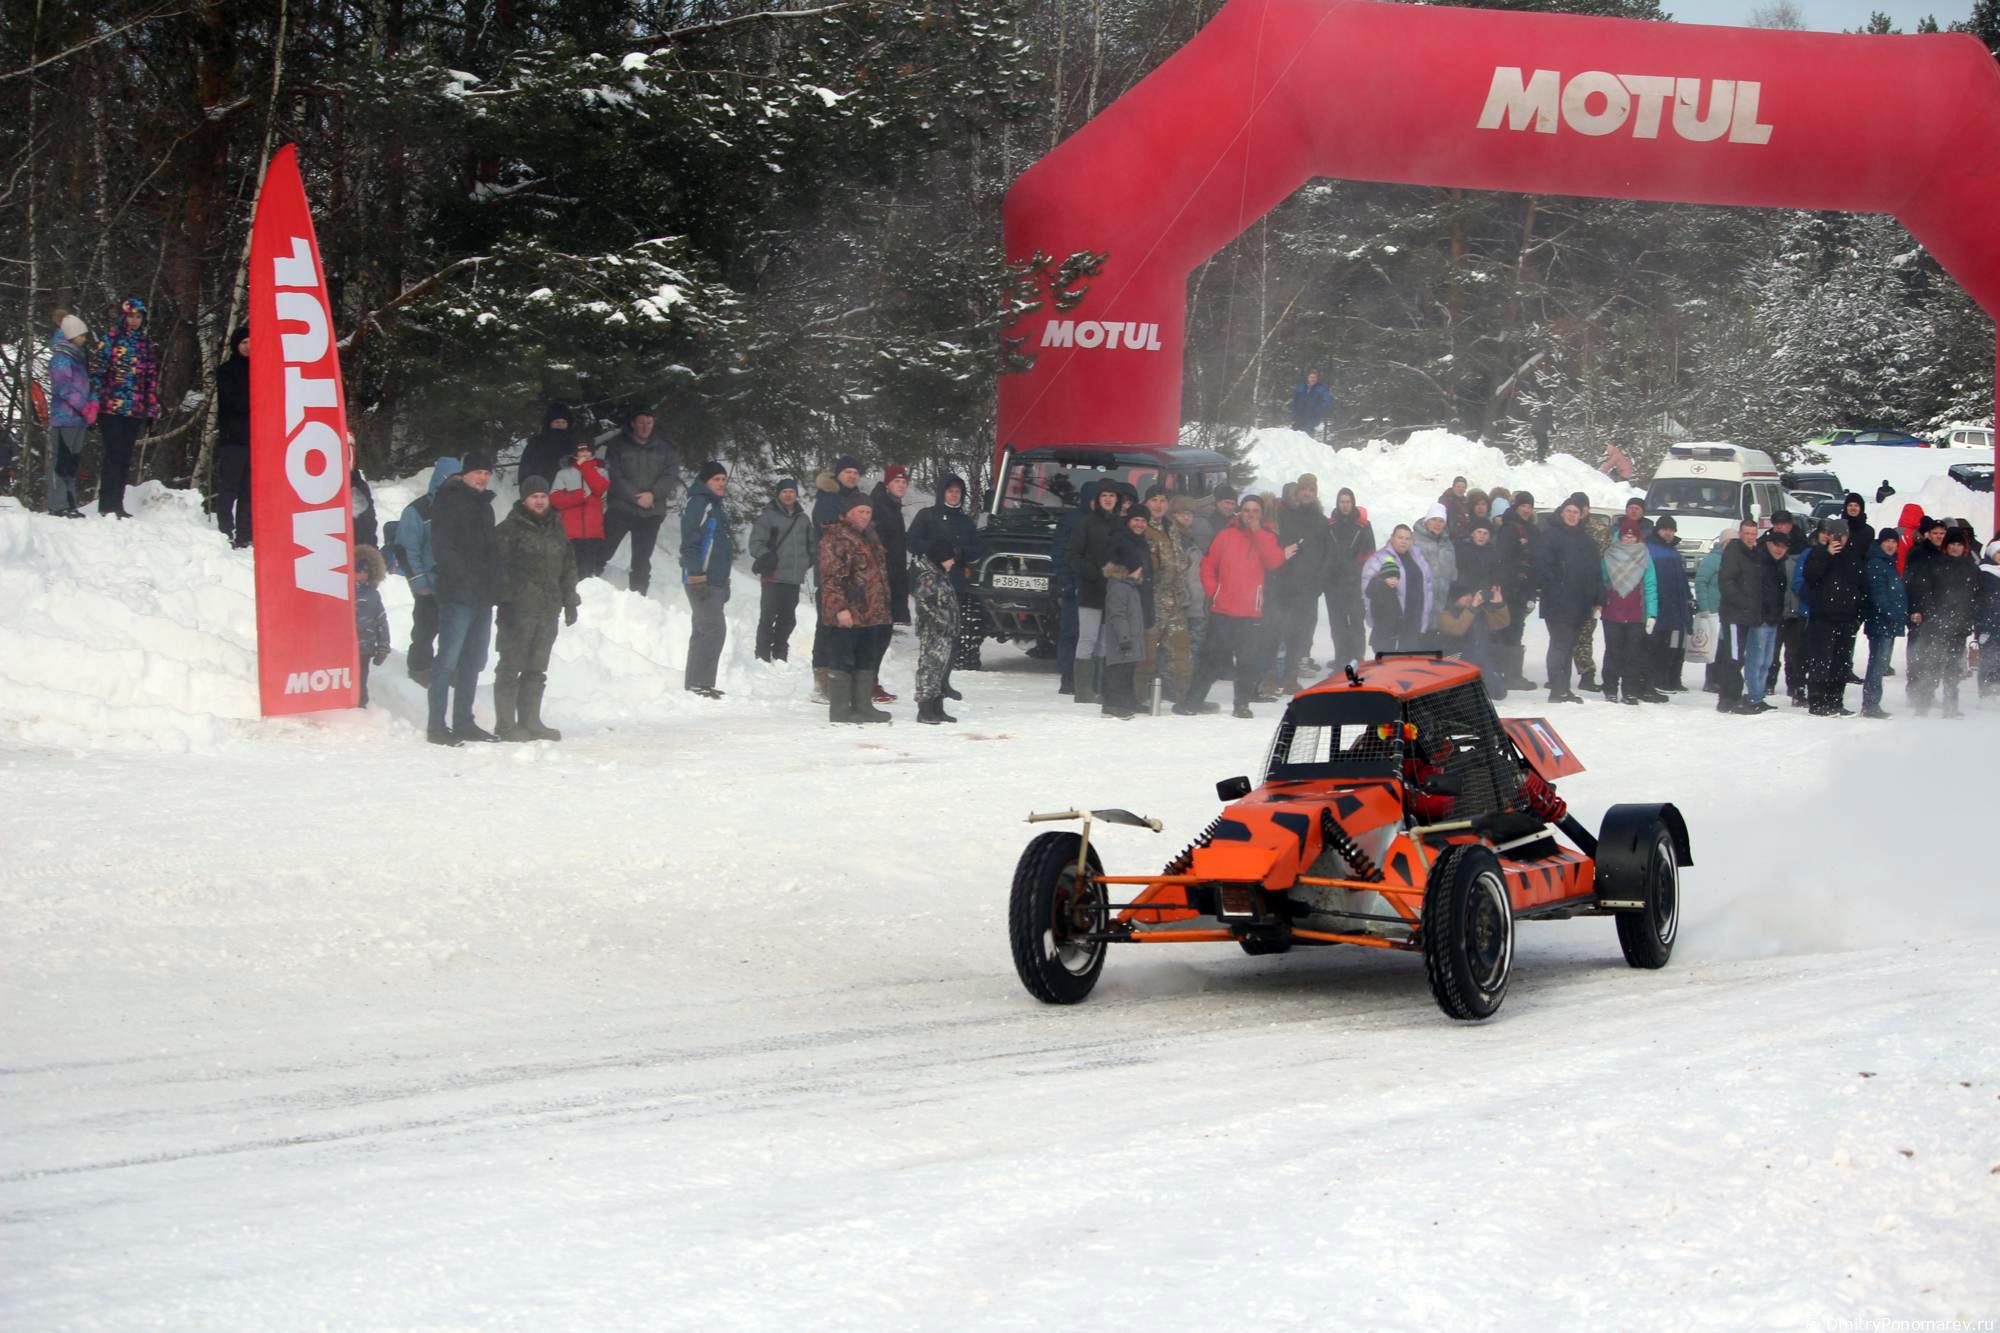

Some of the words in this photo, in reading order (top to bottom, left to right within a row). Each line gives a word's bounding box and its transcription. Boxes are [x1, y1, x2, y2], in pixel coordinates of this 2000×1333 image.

[1476, 66, 1774, 145] MOTUL
[1040, 320, 1161, 350] MOTUL
[272, 236, 349, 600] MOTUL
